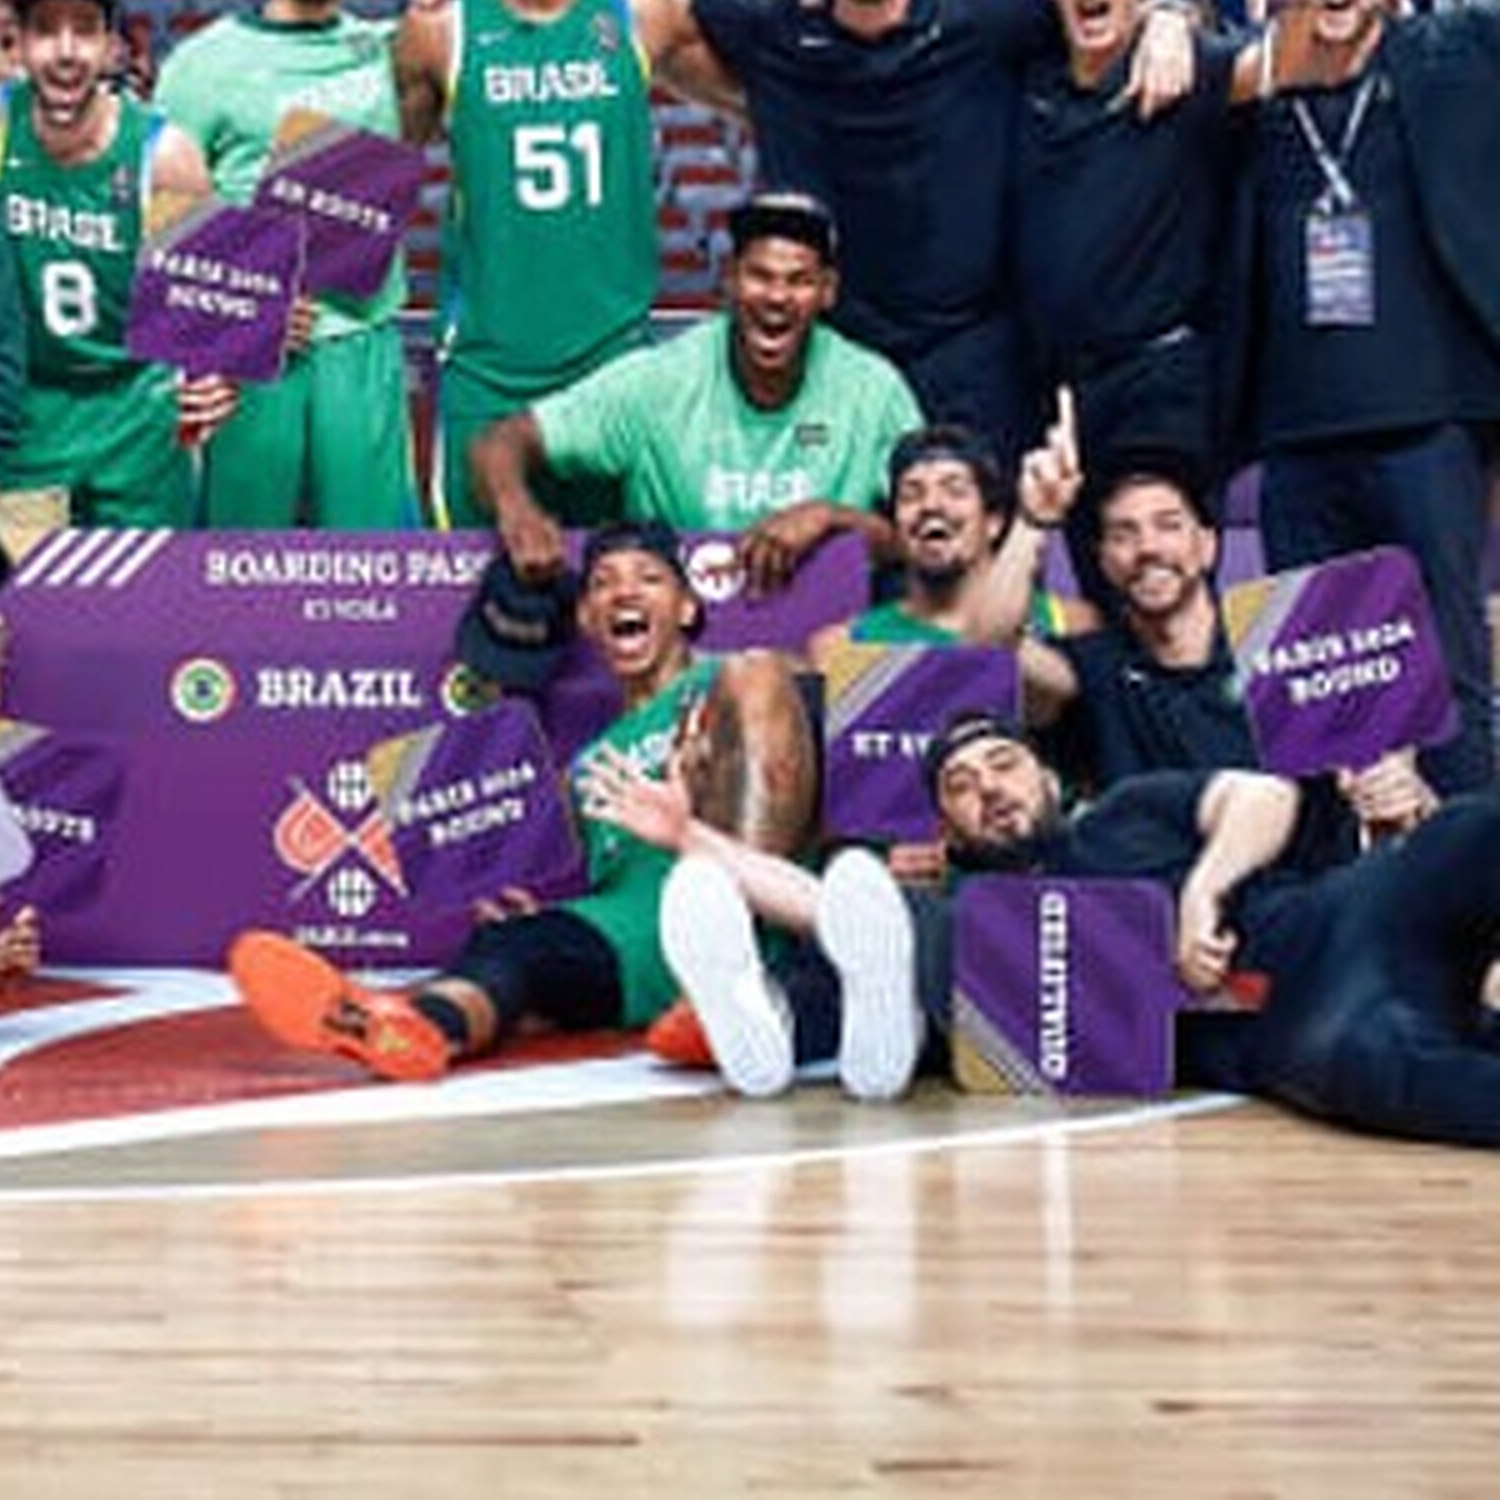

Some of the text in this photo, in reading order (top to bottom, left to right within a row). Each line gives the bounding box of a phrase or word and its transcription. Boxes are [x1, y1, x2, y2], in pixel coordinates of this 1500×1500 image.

[483, 60, 620, 104] BRASIL
[514, 120, 603, 211] 51
[42, 259, 99, 336] 8
[206, 550, 400, 586] BOARDING
[256, 668, 423, 707] BRAZIL
